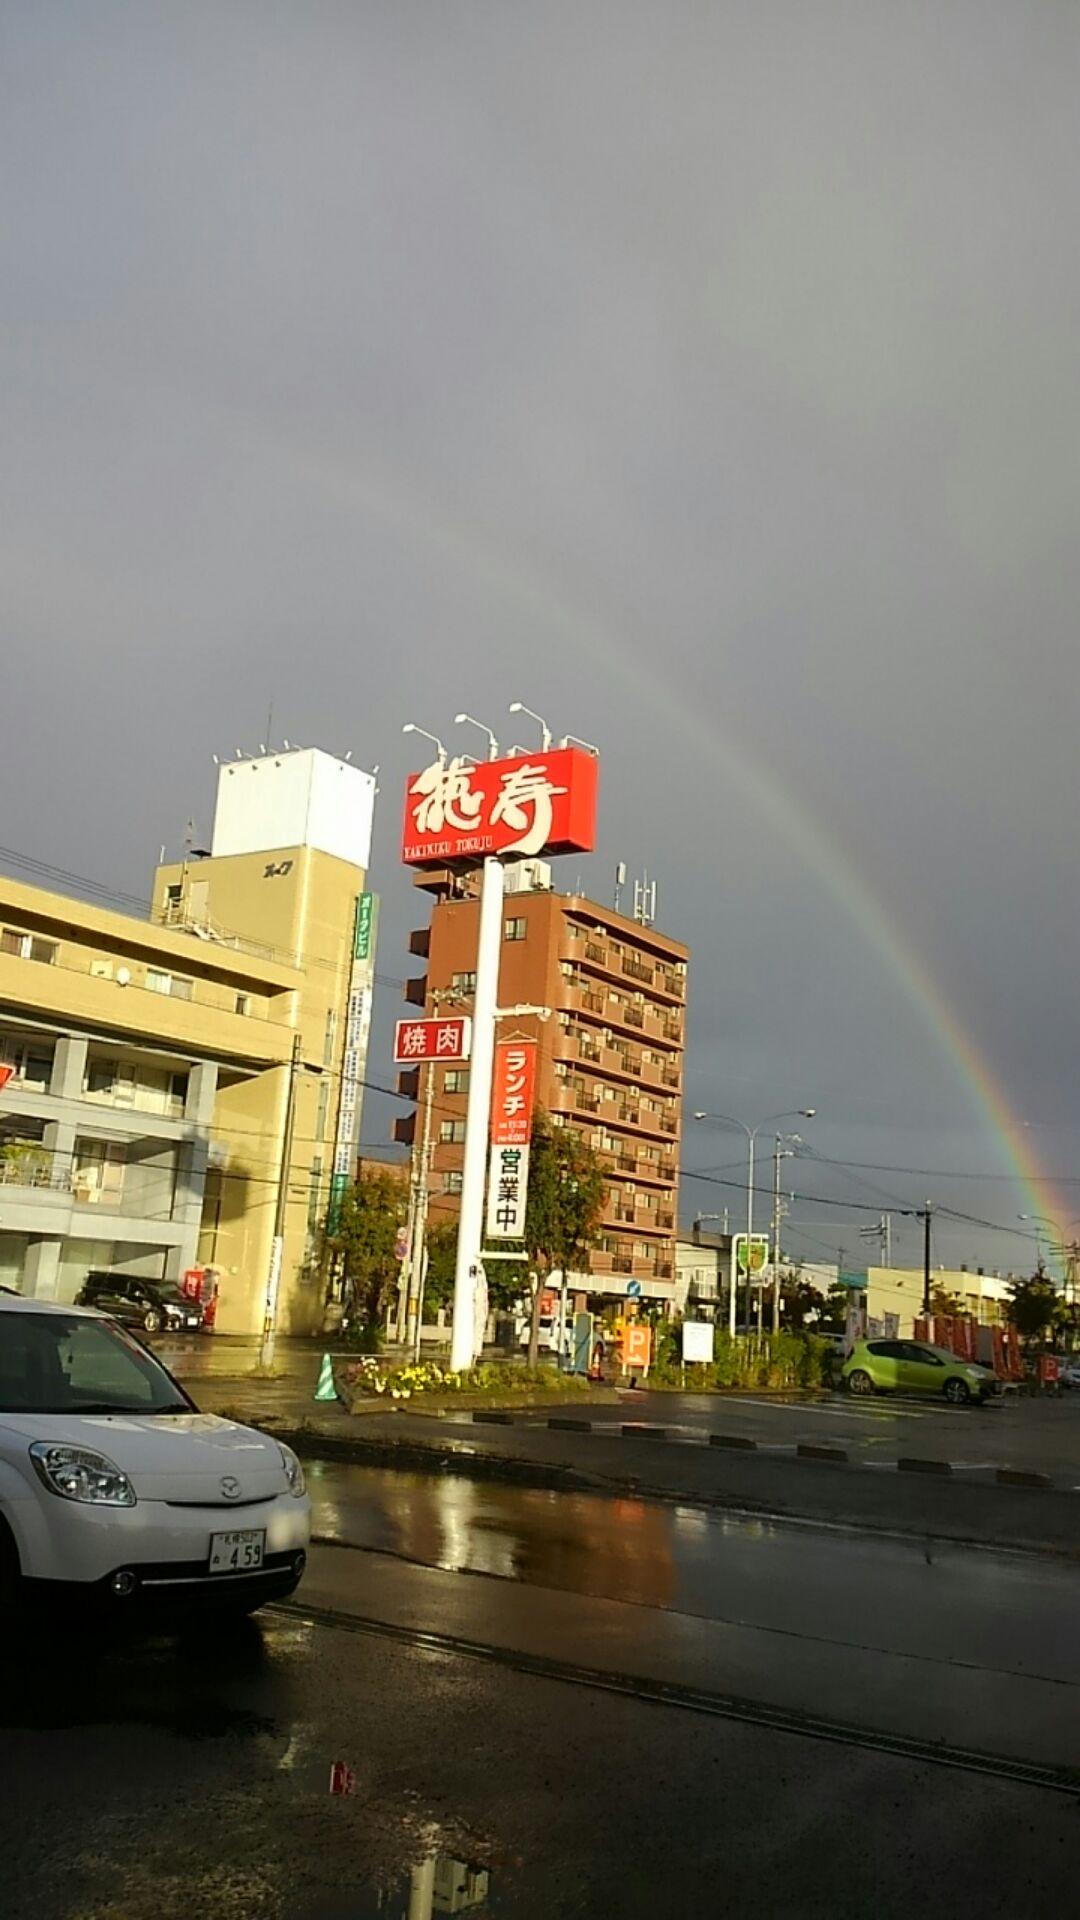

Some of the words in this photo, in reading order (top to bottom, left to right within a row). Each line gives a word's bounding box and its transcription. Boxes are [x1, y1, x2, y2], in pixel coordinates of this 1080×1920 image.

[456, 835, 493, 852] TOKUJU
[403, 1024, 460, 1056] 焼肉
[503, 1050, 526, 1117] ランチ
[497, 1148, 521, 1232] 営業中
[629, 1330, 645, 1354] P
